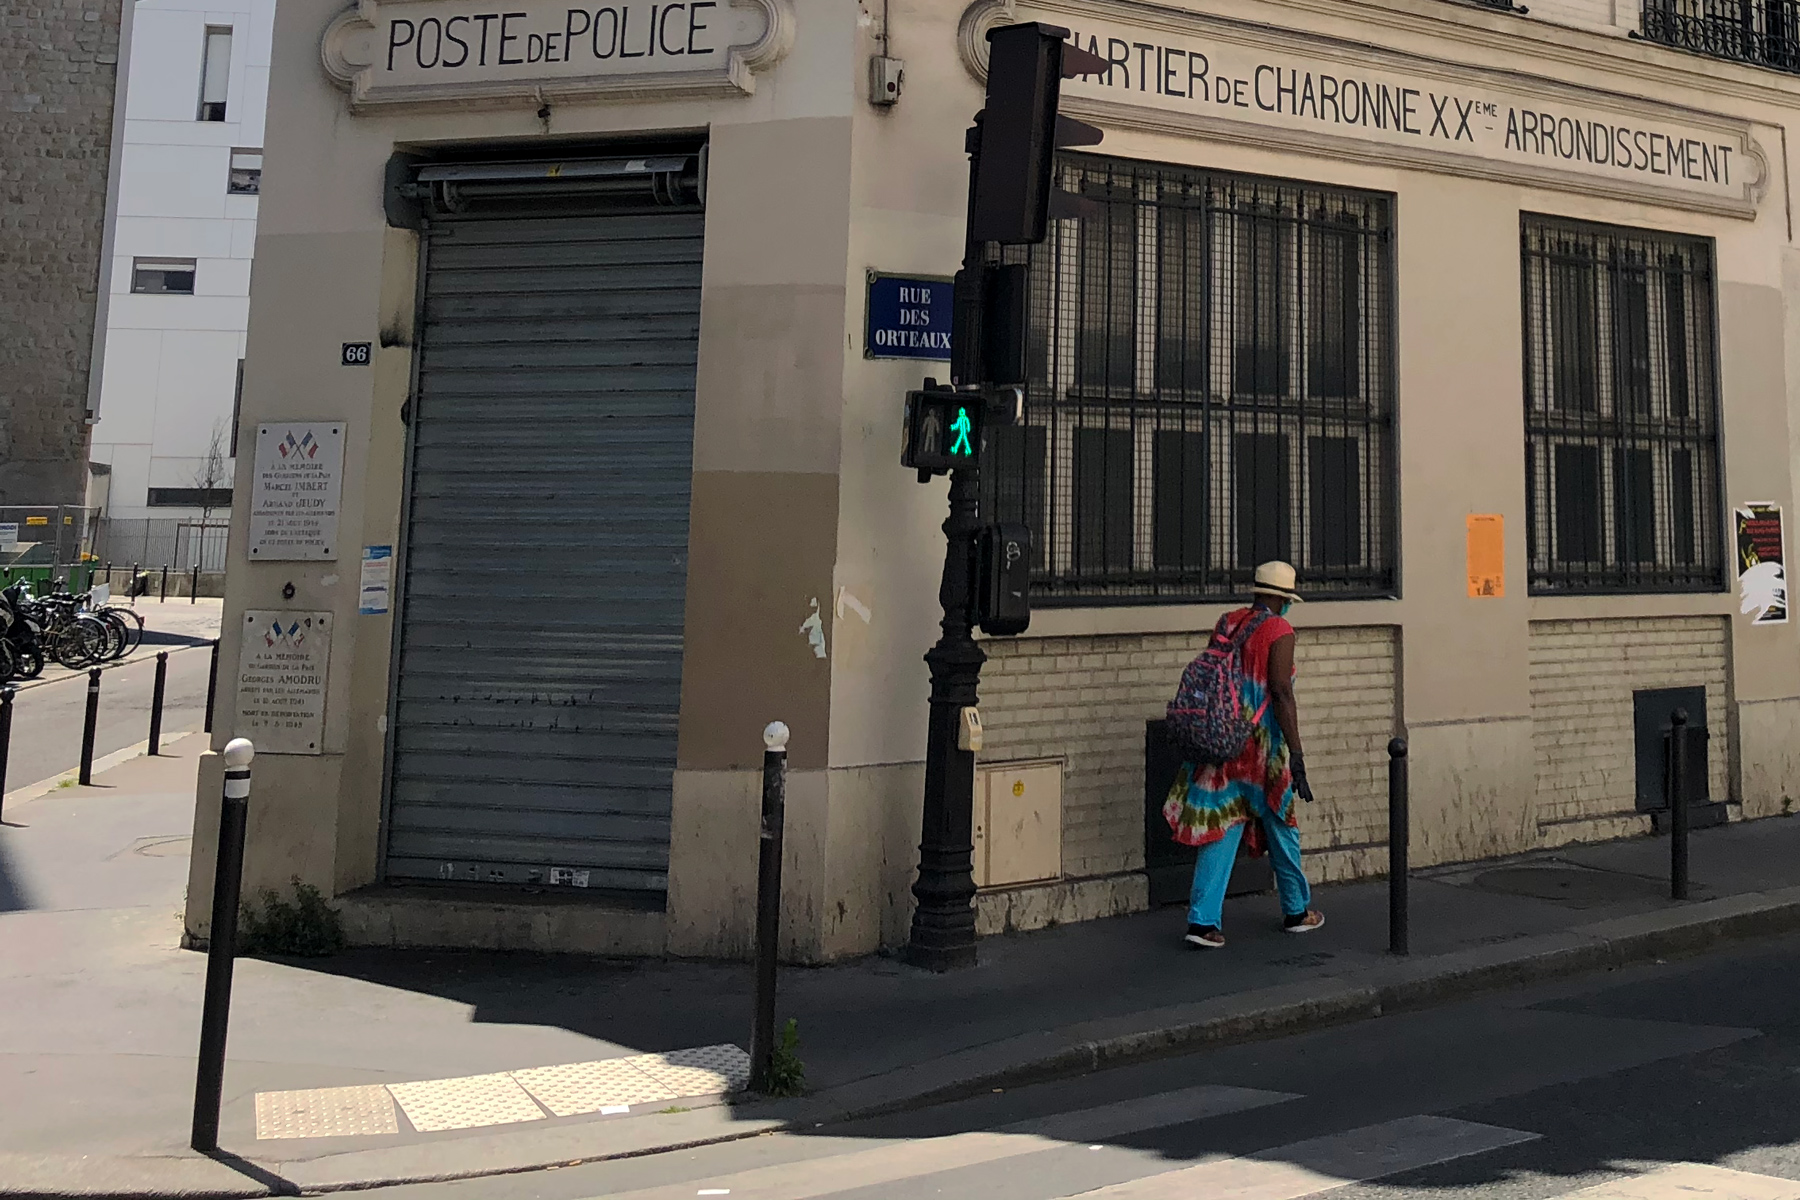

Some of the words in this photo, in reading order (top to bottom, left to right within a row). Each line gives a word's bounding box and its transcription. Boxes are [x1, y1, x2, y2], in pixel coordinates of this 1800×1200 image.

[386, 11, 528, 72] POSTE
[527, 32, 561, 64] DE
[564, 0, 718, 63] POLICE
[1215, 76, 1250, 108] DE
[1253, 64, 1422, 135] CHARONNE
[1504, 106, 1734, 186] ARRONDISSEMENT
[899, 287, 932, 305] RUE
[899, 308, 930, 327] DES
[875, 328, 952, 350] ORTEAUX
[345, 346, 368, 362] 66
[295, 481, 329, 491] IMBERT
[278, 675, 322, 686] AMODRU
